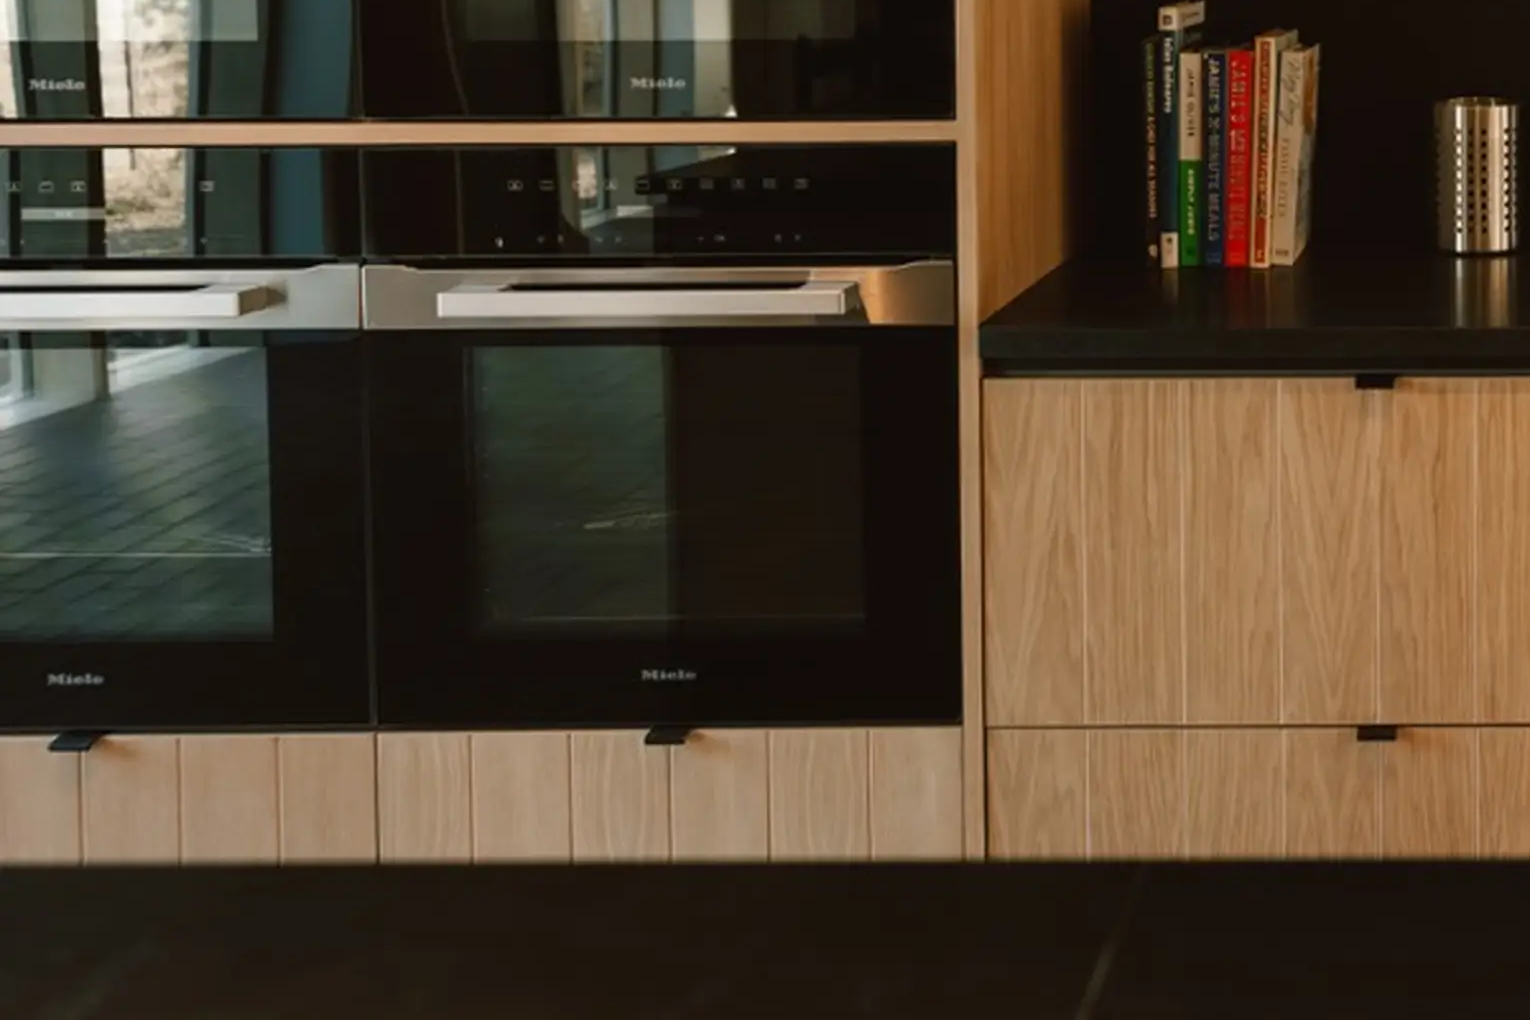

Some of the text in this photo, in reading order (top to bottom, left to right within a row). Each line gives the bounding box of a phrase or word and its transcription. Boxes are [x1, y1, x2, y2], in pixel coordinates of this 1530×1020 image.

[28, 78, 86, 91] Miele
[629, 76, 686, 89] Miele
[1208, 193, 1221, 242] MEALS
[46, 673, 105, 686] Miele
[640, 669, 697, 681] Miele
